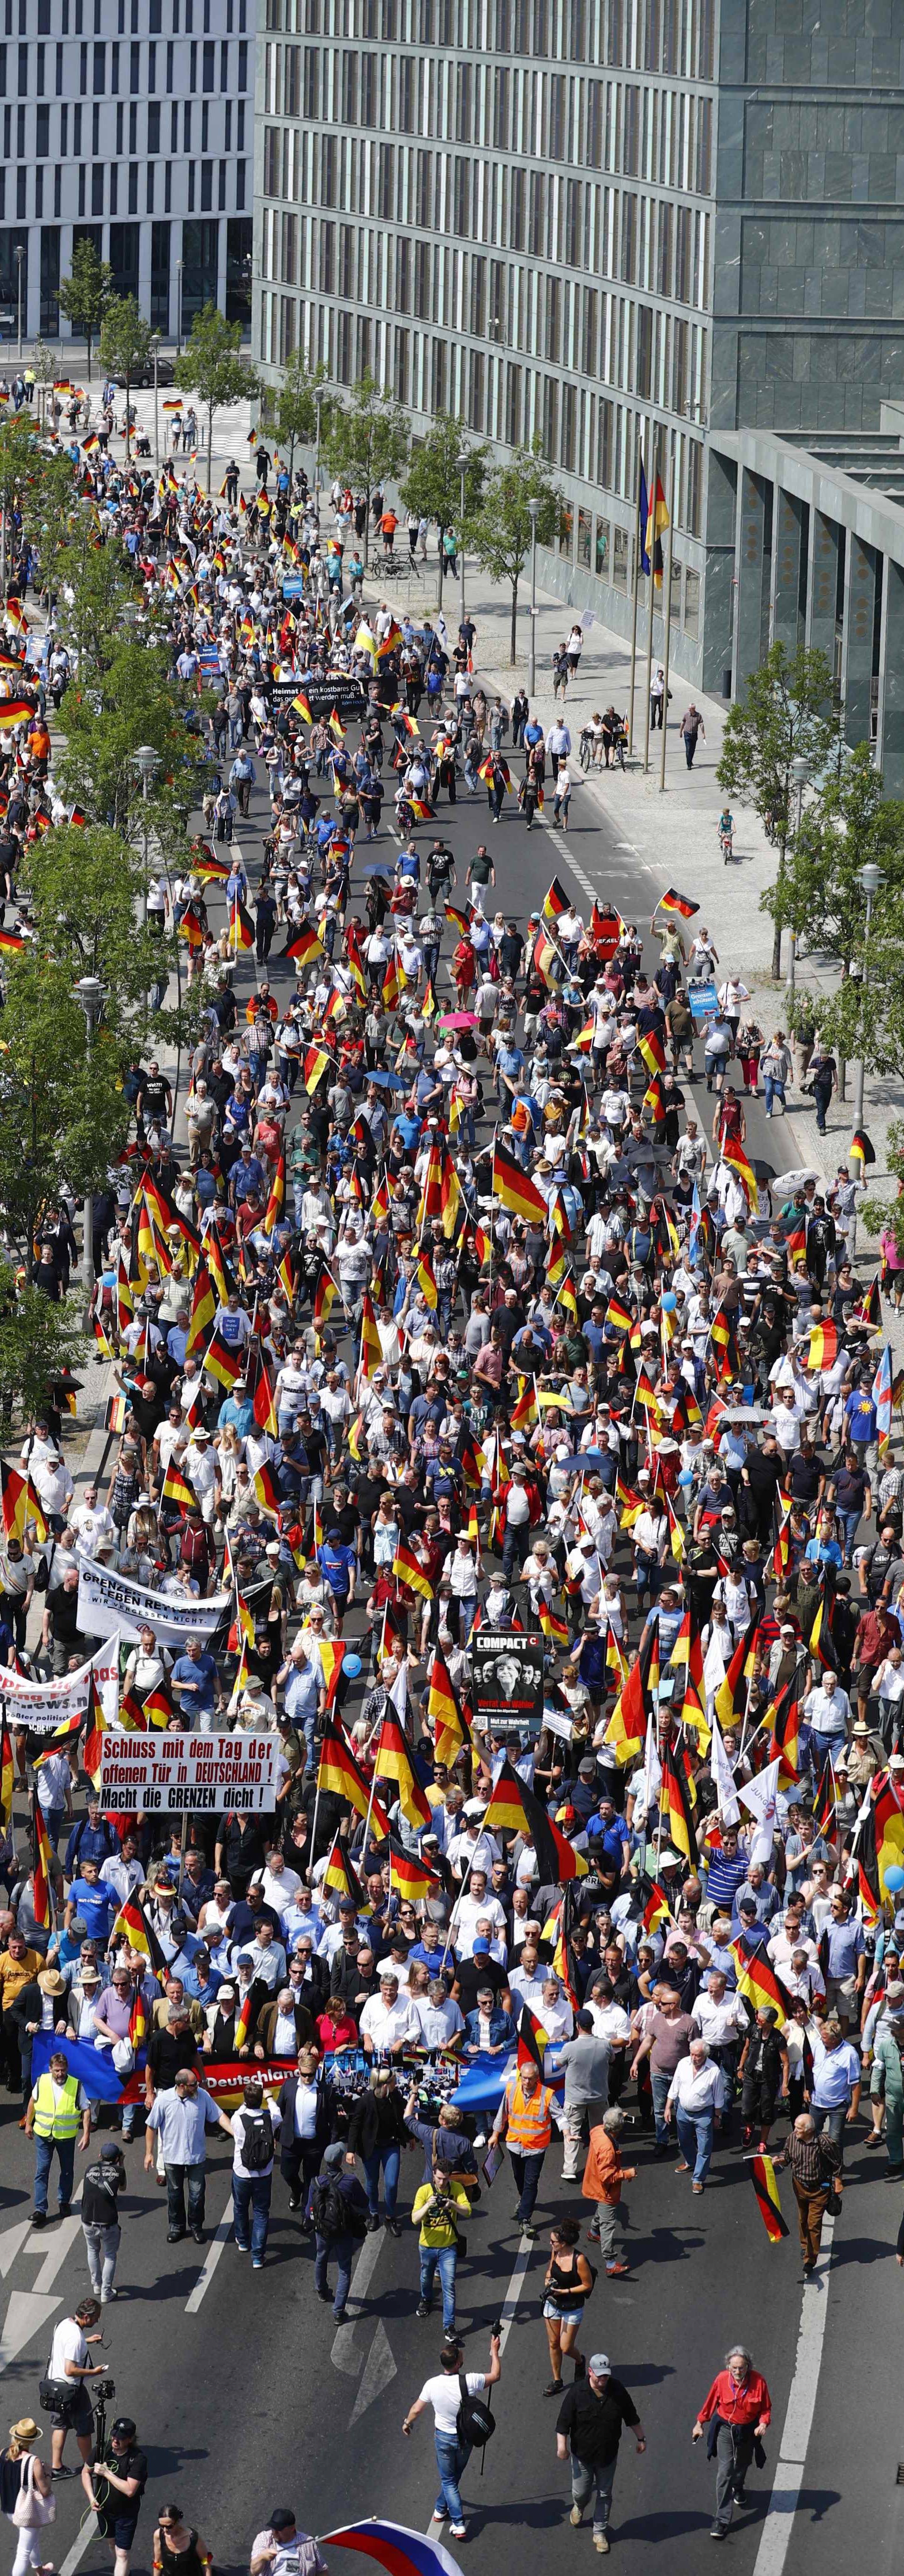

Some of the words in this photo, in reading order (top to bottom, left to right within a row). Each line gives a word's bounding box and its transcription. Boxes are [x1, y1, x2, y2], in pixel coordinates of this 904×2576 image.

[320, 685, 349, 693] kostbares
[83, 1572, 141, 1596] GRENZE
[100, 1587, 140, 1606] LEBEN
[113, 1602, 168, 1619] VERGESSEN
[476, 1637, 527, 1650] COMPACT
[477, 1699, 498, 1707] Verrat
[512, 1700, 535, 1708] Wähler
[104, 1738, 155, 1759] Schluss
[162, 1738, 184, 1759] mit
[189, 1739, 213, 1759] dem
[218, 1739, 242, 1761] Tag
[249, 1739, 272, 1760] der
[103, 1764, 147, 1784] offenen
[152, 1763, 171, 1783] Tür
[177, 1763, 187, 1783] in
[195, 1762, 262, 1783] DEUTSCHLAND
[267, 1762, 273, 1783] !
[101, 1787, 137, 1809] Macht
[143, 1787, 161, 1808] die
[168, 1787, 216, 1809] GRENZEN
[223, 1787, 254, 1808] dicht
[258, 1787, 264, 1808] !
[751, 1787, 769, 1806] JUNG
